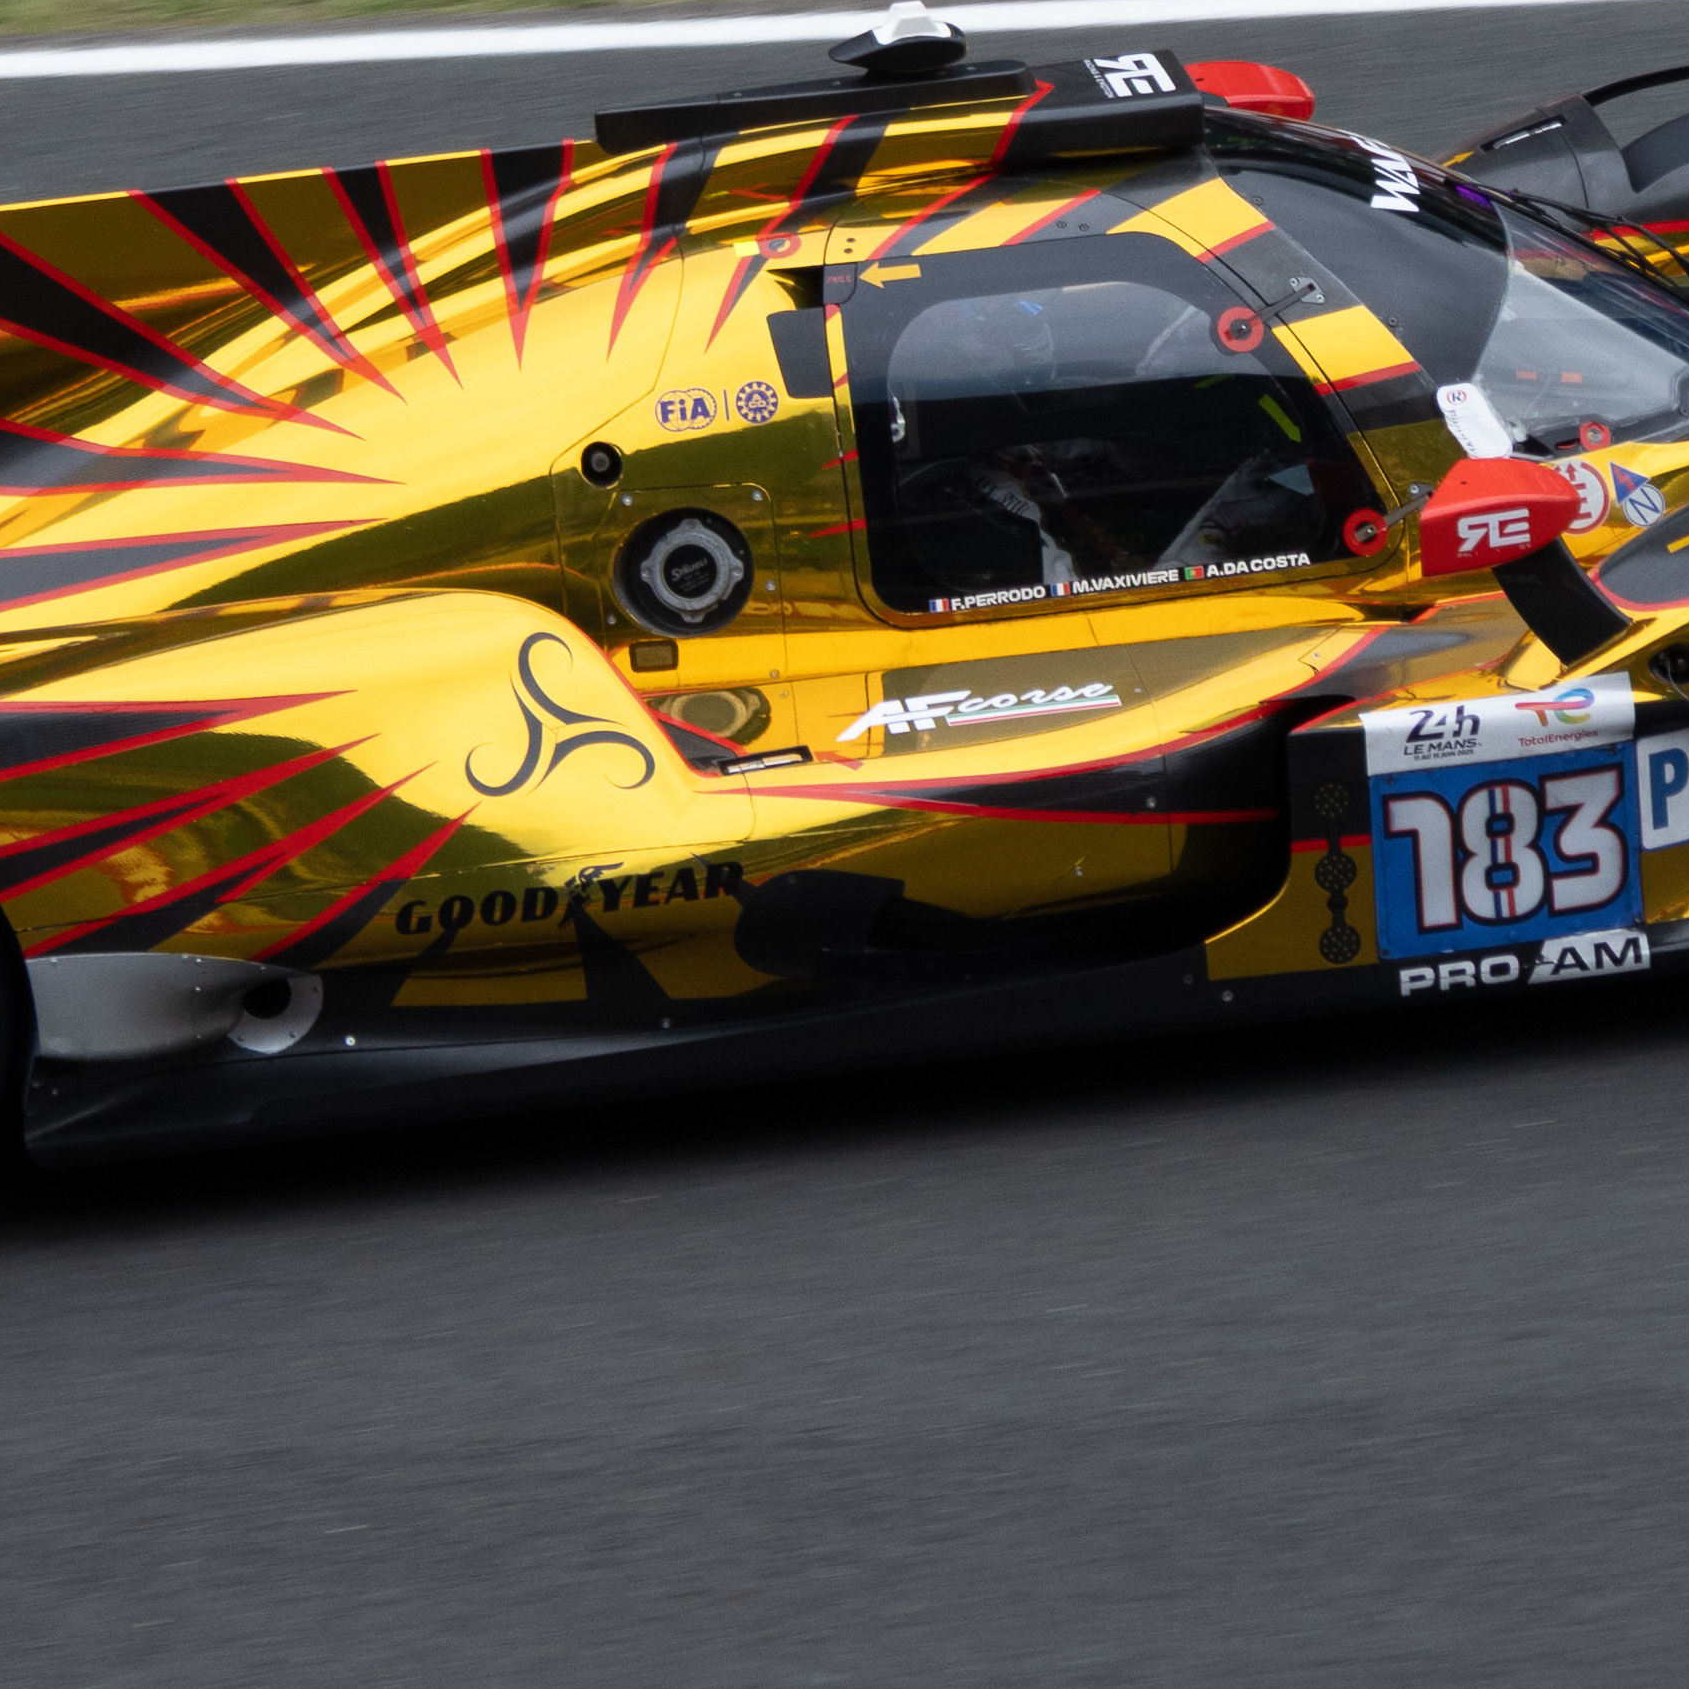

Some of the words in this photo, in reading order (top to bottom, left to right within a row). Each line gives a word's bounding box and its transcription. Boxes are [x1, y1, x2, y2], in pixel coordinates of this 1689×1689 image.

[1073, 569, 1179, 594] M.VAXIVIERE
[951, 586, 1045, 610] F.PERRODO
[958, 682, 1114, 713] corse
[1406, 705, 1480, 743] 24h
[1518, 729, 1598, 746] TotalEnergies
[1404, 744, 1424, 755] LE
[1428, 738, 1477, 752] MANS
[1385, 767, 1625, 931] 183
[394, 860, 744, 936] GOODYEAR
[1399, 955, 1519, 996] PRO
[1550, 937, 1643, 974] AM
